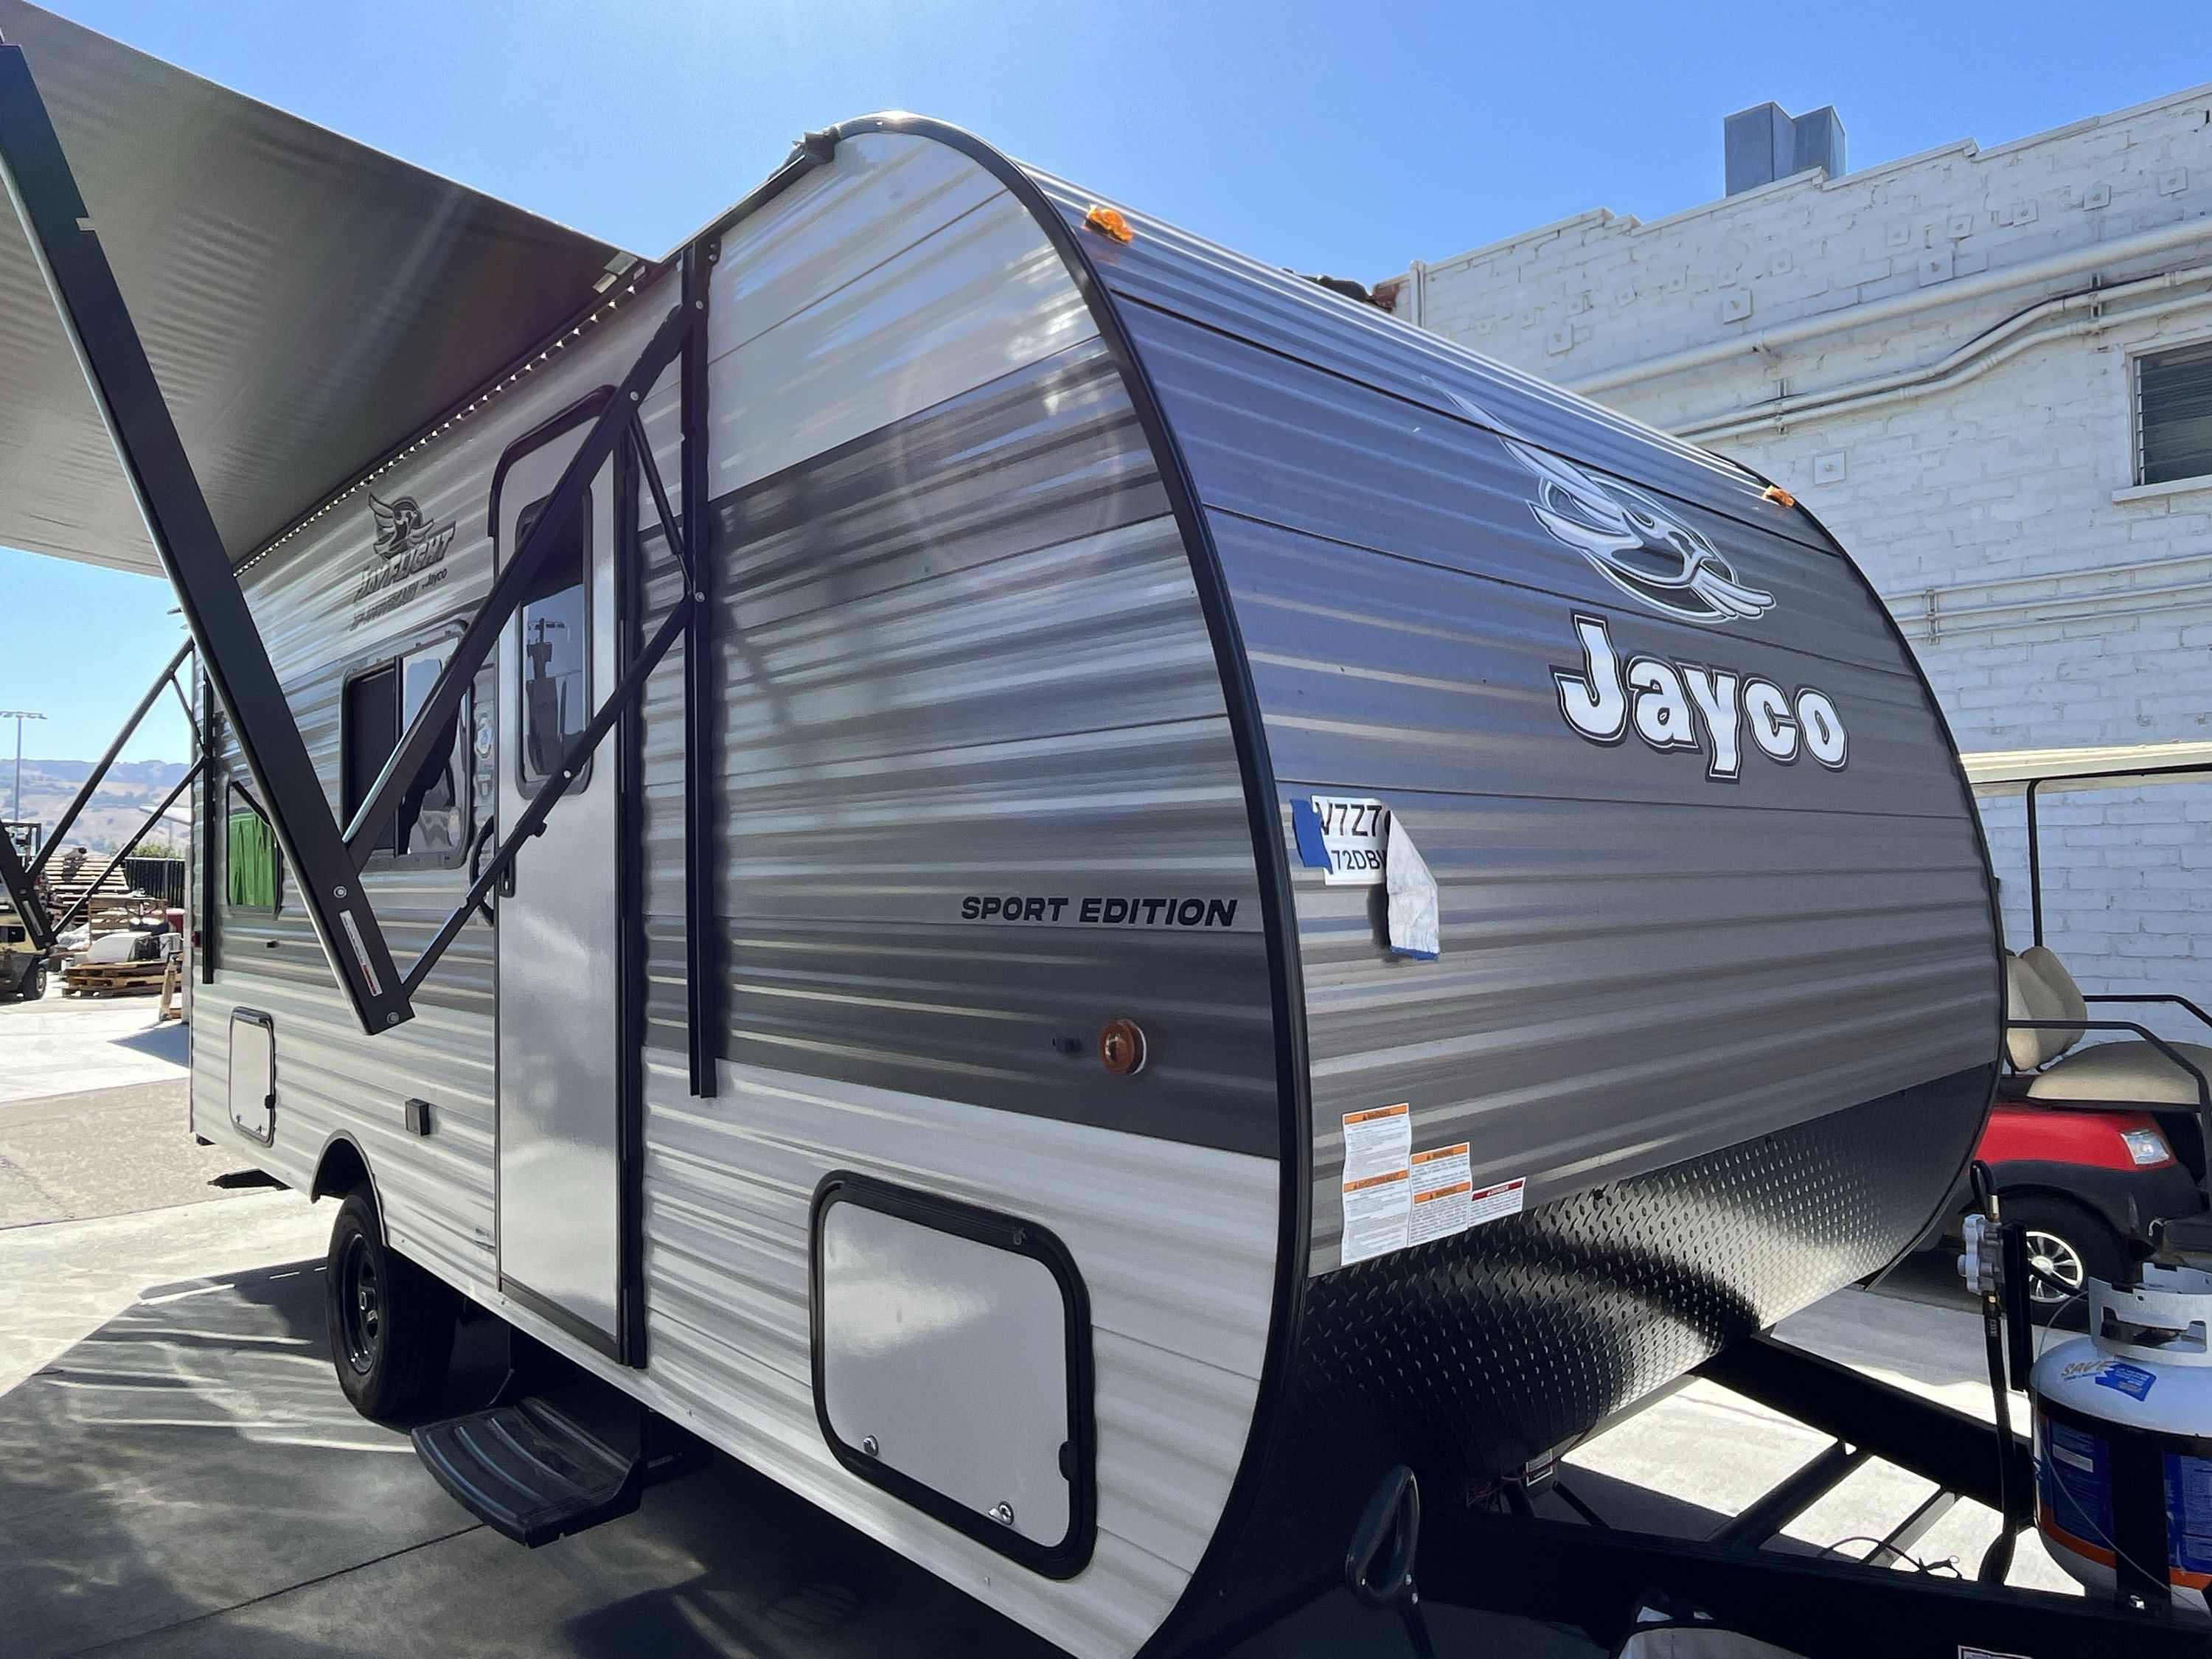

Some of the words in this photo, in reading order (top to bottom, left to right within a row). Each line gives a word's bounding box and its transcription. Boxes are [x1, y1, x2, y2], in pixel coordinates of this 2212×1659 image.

[1550, 609, 1850, 783] Jayco
[961, 896, 1069, 922] SPORT
[1079, 897, 1238, 927] EDITION
